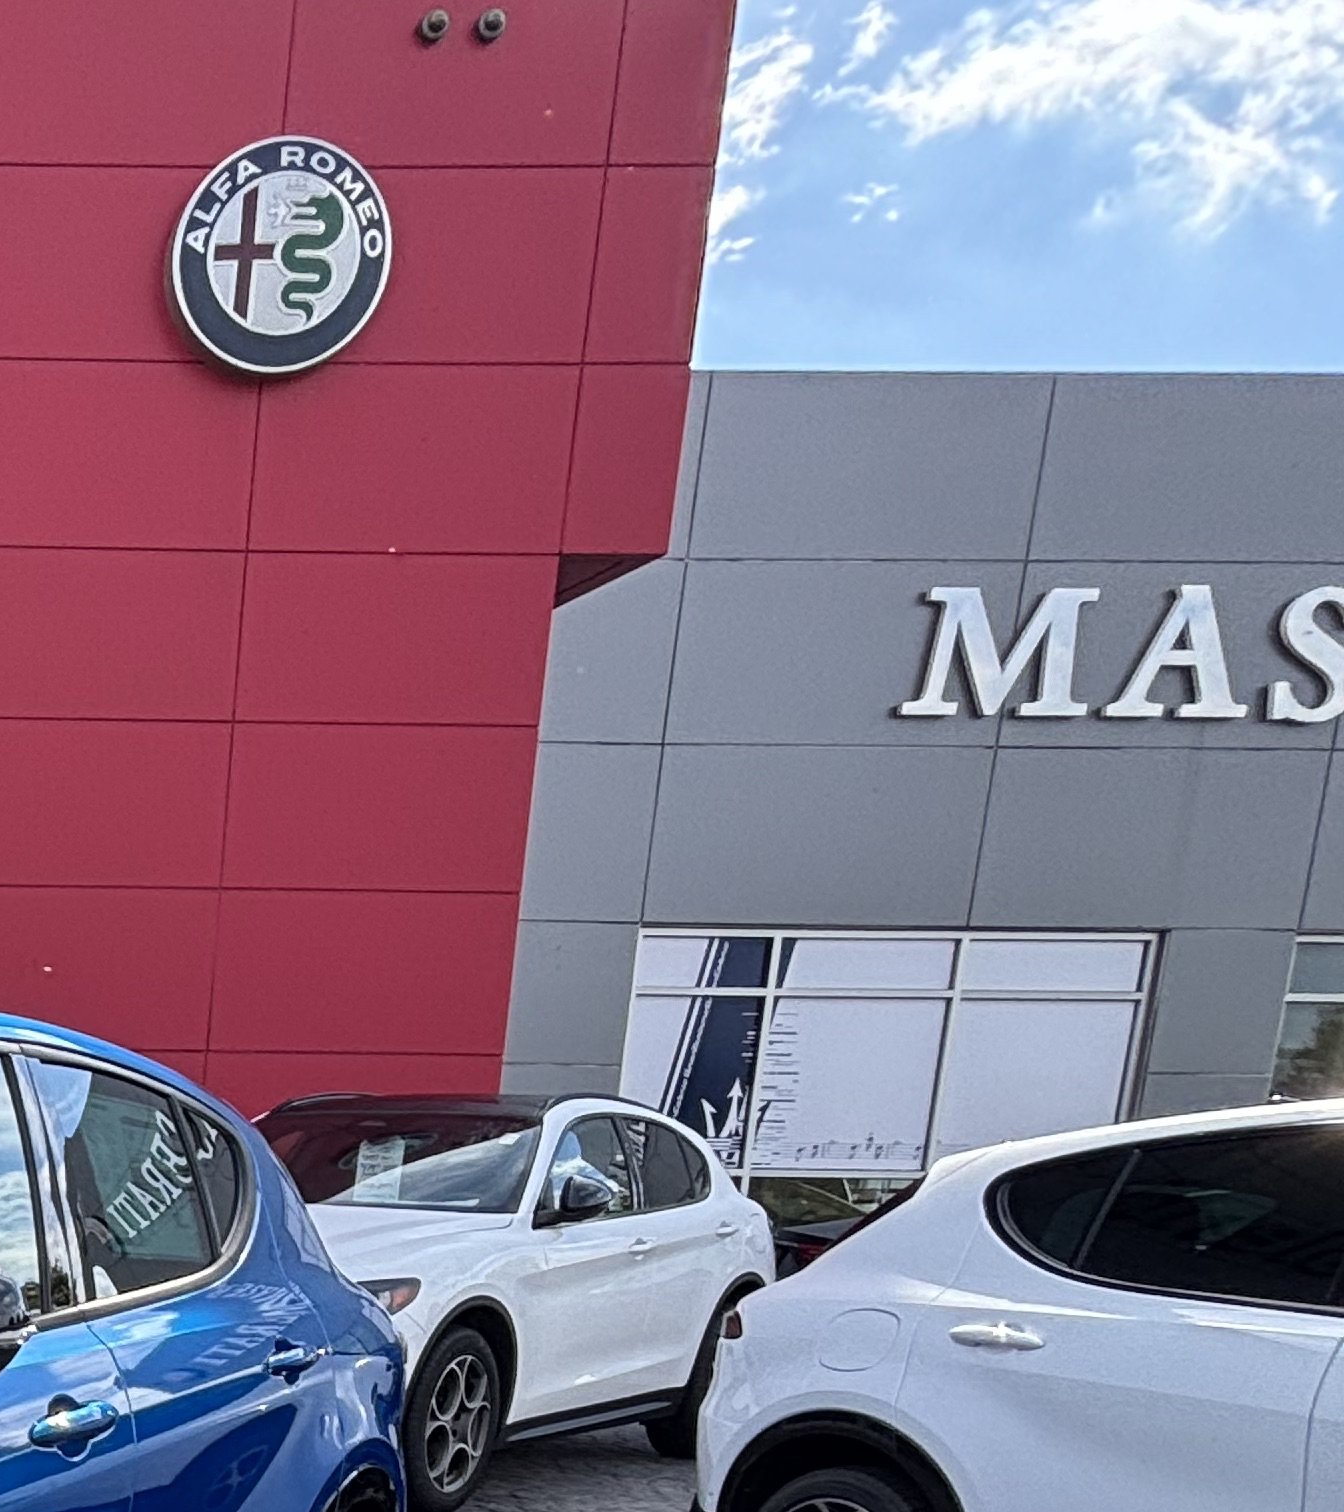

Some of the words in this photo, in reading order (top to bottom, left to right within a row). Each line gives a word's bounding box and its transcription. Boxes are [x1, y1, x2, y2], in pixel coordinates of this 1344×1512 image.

[184, 158, 263, 255] ALFA
[279, 145, 384, 259] ROMEO
[897, 584, 1344, 723] MAS
